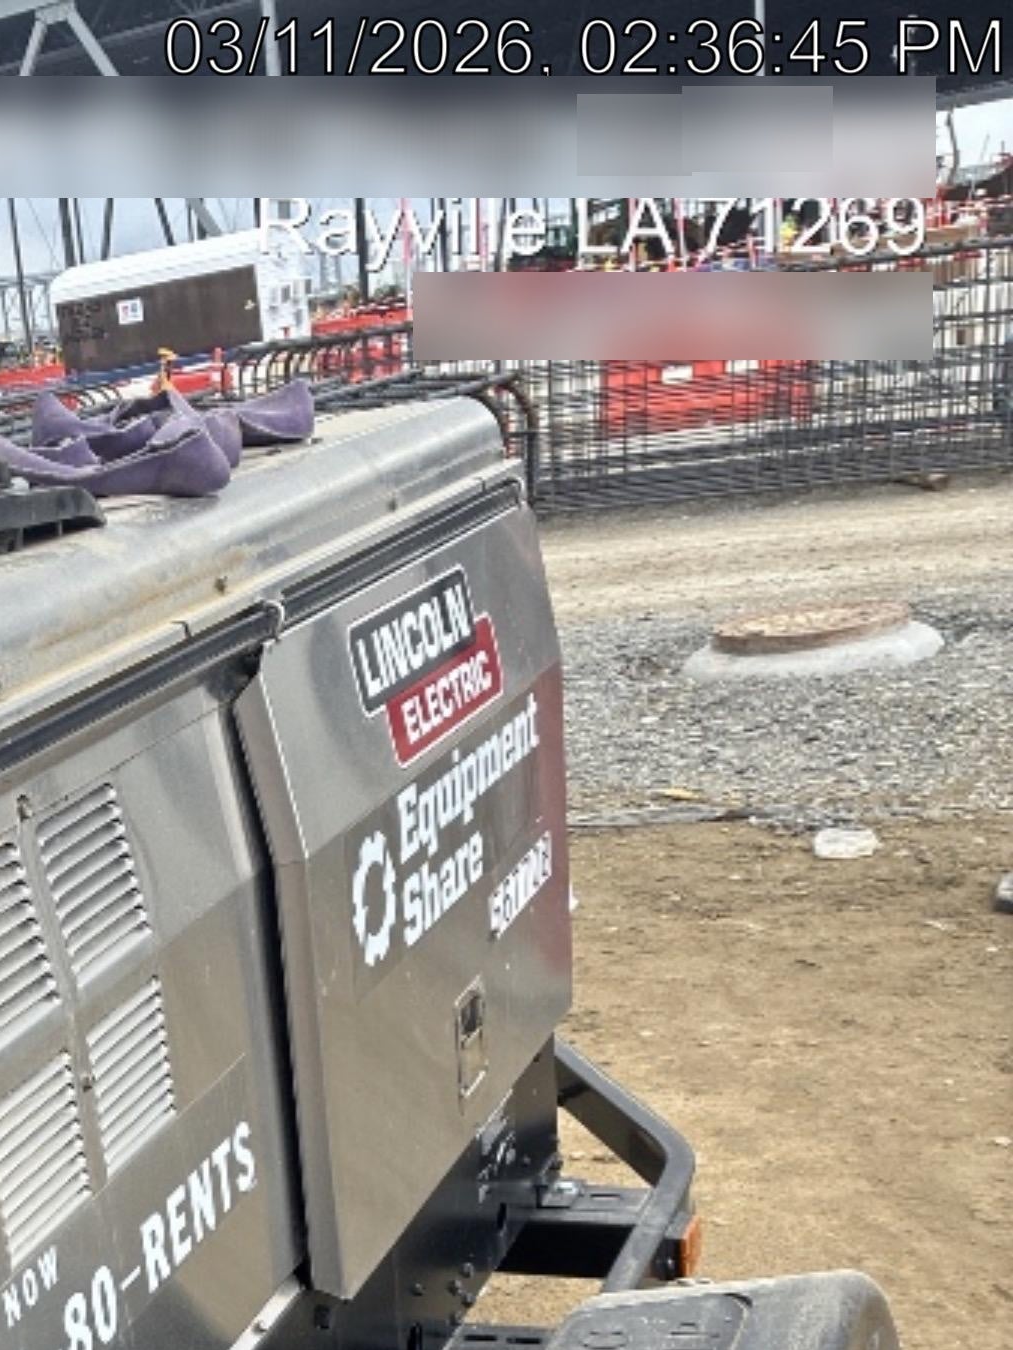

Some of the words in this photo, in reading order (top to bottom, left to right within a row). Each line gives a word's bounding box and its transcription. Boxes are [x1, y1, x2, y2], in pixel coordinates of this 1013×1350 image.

[355, 584, 473, 695] LINCOLN
[401, 650, 493, 745] ELECTRIC
[397, 692, 541, 866] Equipment
[402, 831, 485, 947] Share
[1, 1244, 61, 1328] NOW
